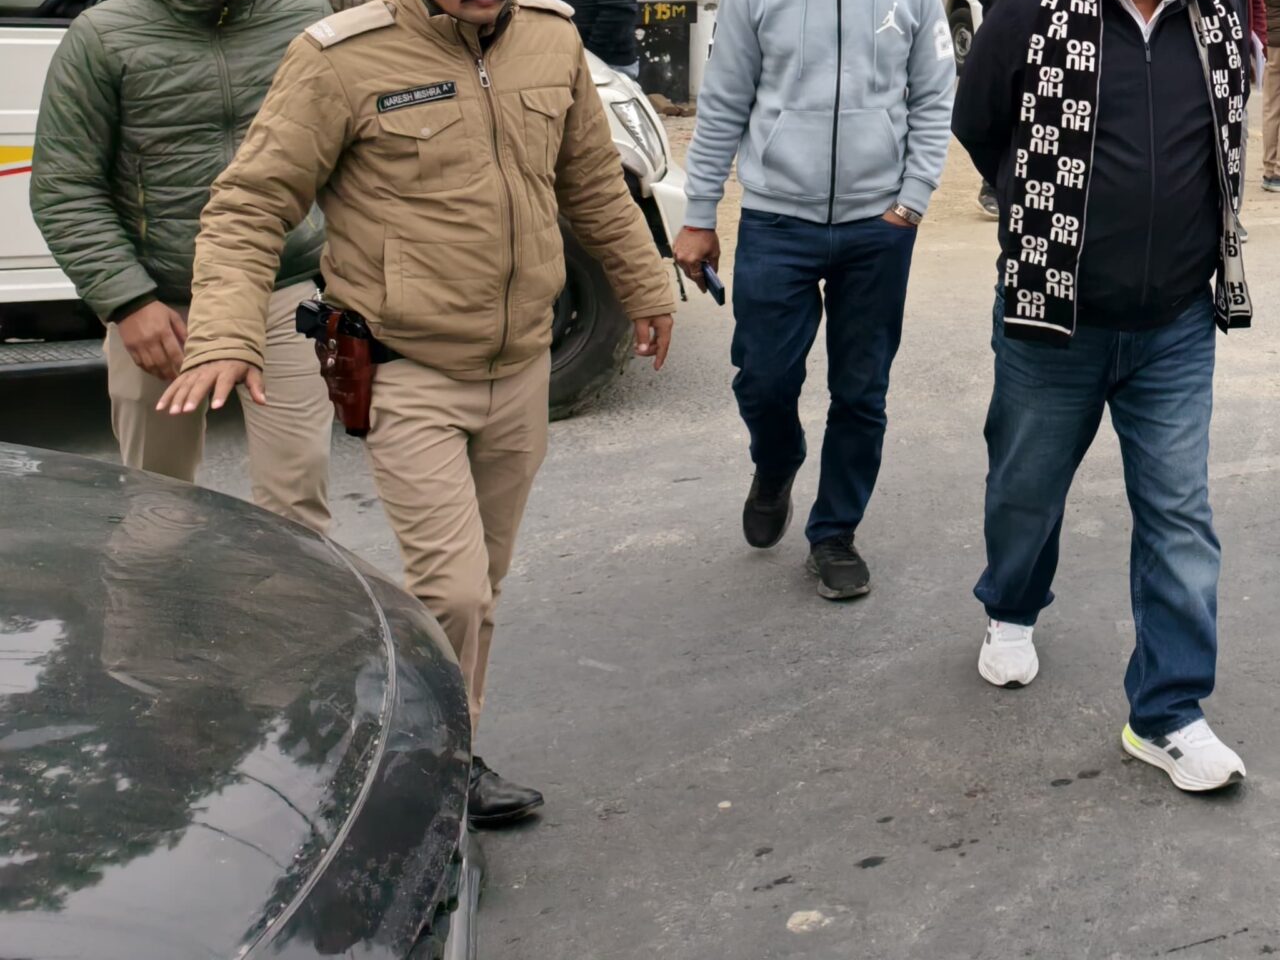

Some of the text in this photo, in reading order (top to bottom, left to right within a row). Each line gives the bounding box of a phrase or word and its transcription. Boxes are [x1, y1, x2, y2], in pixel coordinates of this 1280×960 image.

[1070, 0, 1097, 17] HU
[1066, 39, 1096, 56] GO
[1066, 54, 1096, 72] HU
[1039, 66, 1064, 82] GO
[1212, 69, 1228, 84] HU
[1037, 81, 1063, 98] HU
[1214, 84, 1230, 99] GO
[384, 93, 413, 107] NARESH
[1062, 98, 1091, 116] GO
[1061, 113, 1090, 132] HU
[1031, 123, 1059, 140] GO
[1029, 137, 1059, 155] HU
[1057, 156, 1085, 174] GO
[1025, 179, 1055, 196] GO
[1056, 170, 1084, 189] HU
[1025, 193, 1054, 211] HU
[1052, 212, 1079, 231] GO
[1021, 235, 1048, 252] GO
[1050, 227, 1078, 246] HU
[1020, 248, 1048, 267] HU
[1045, 268, 1074, 286] GO
[1017, 288, 1045, 305] GO
[1046, 281, 1074, 301] HU
[1016, 302, 1045, 319] HU
